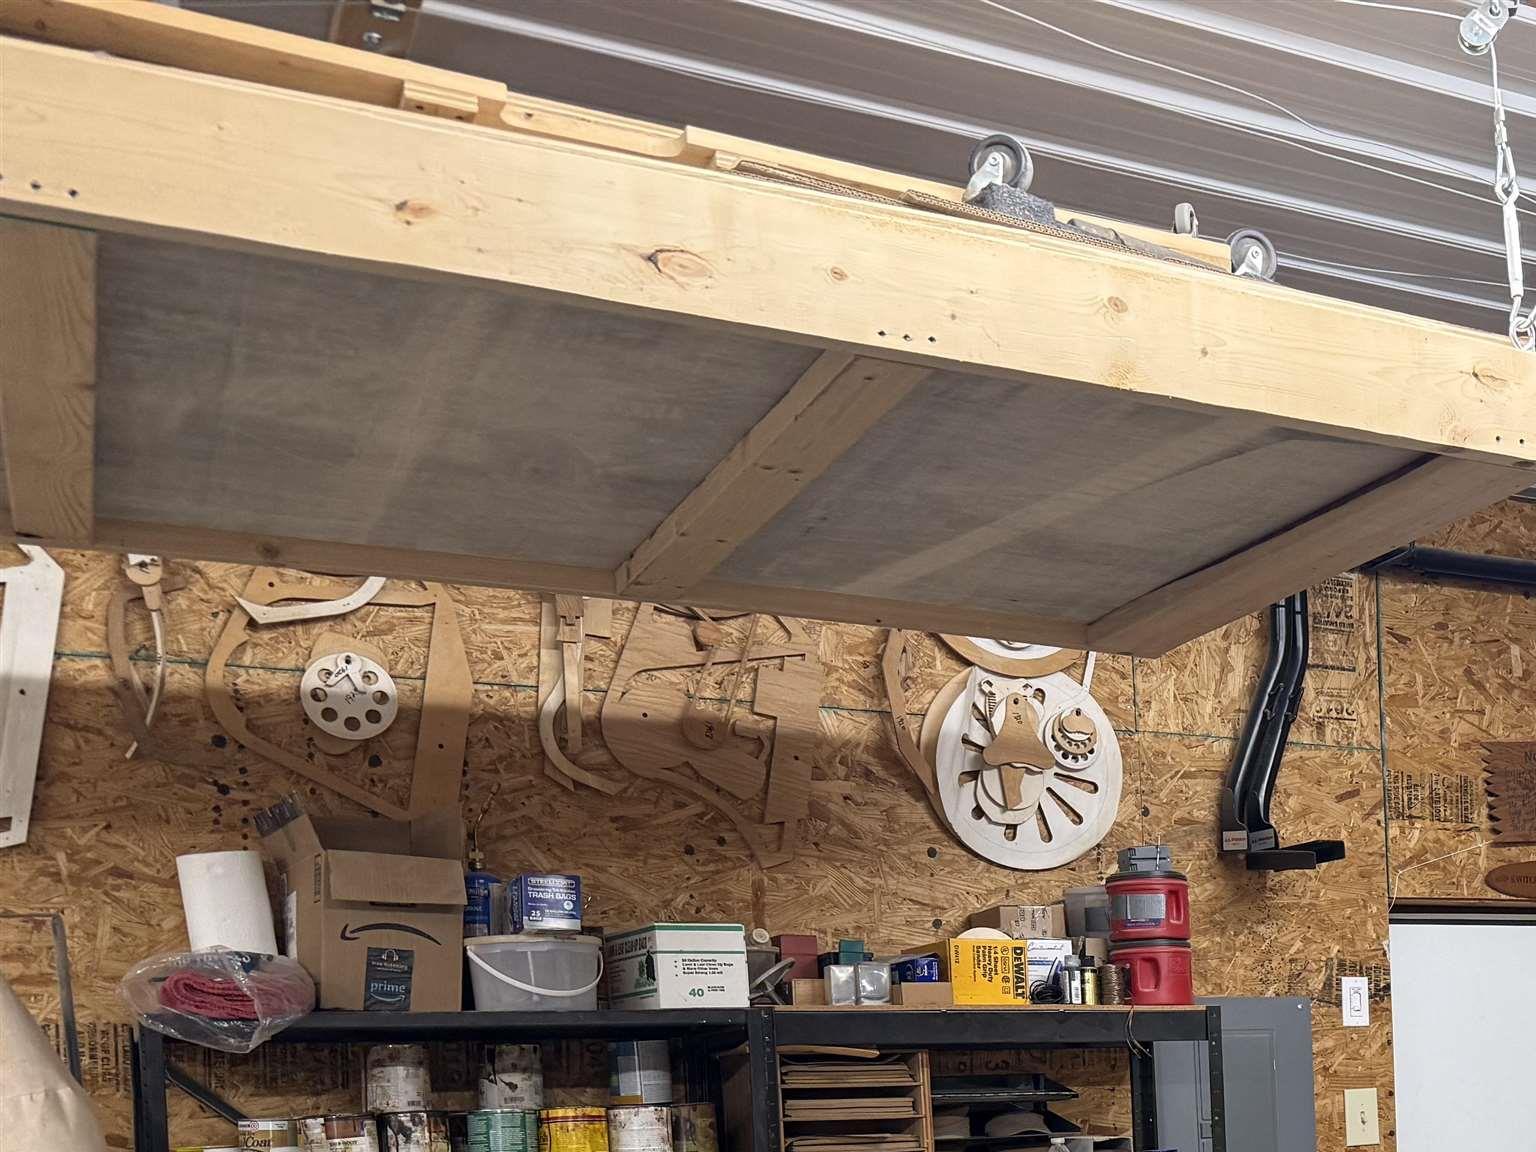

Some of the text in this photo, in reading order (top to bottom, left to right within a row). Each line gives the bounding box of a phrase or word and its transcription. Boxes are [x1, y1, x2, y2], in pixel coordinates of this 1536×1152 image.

[528, 892, 576, 901] TRASH BAGS
[370, 981, 406, 992] prime
[689, 988, 704, 997] 40
